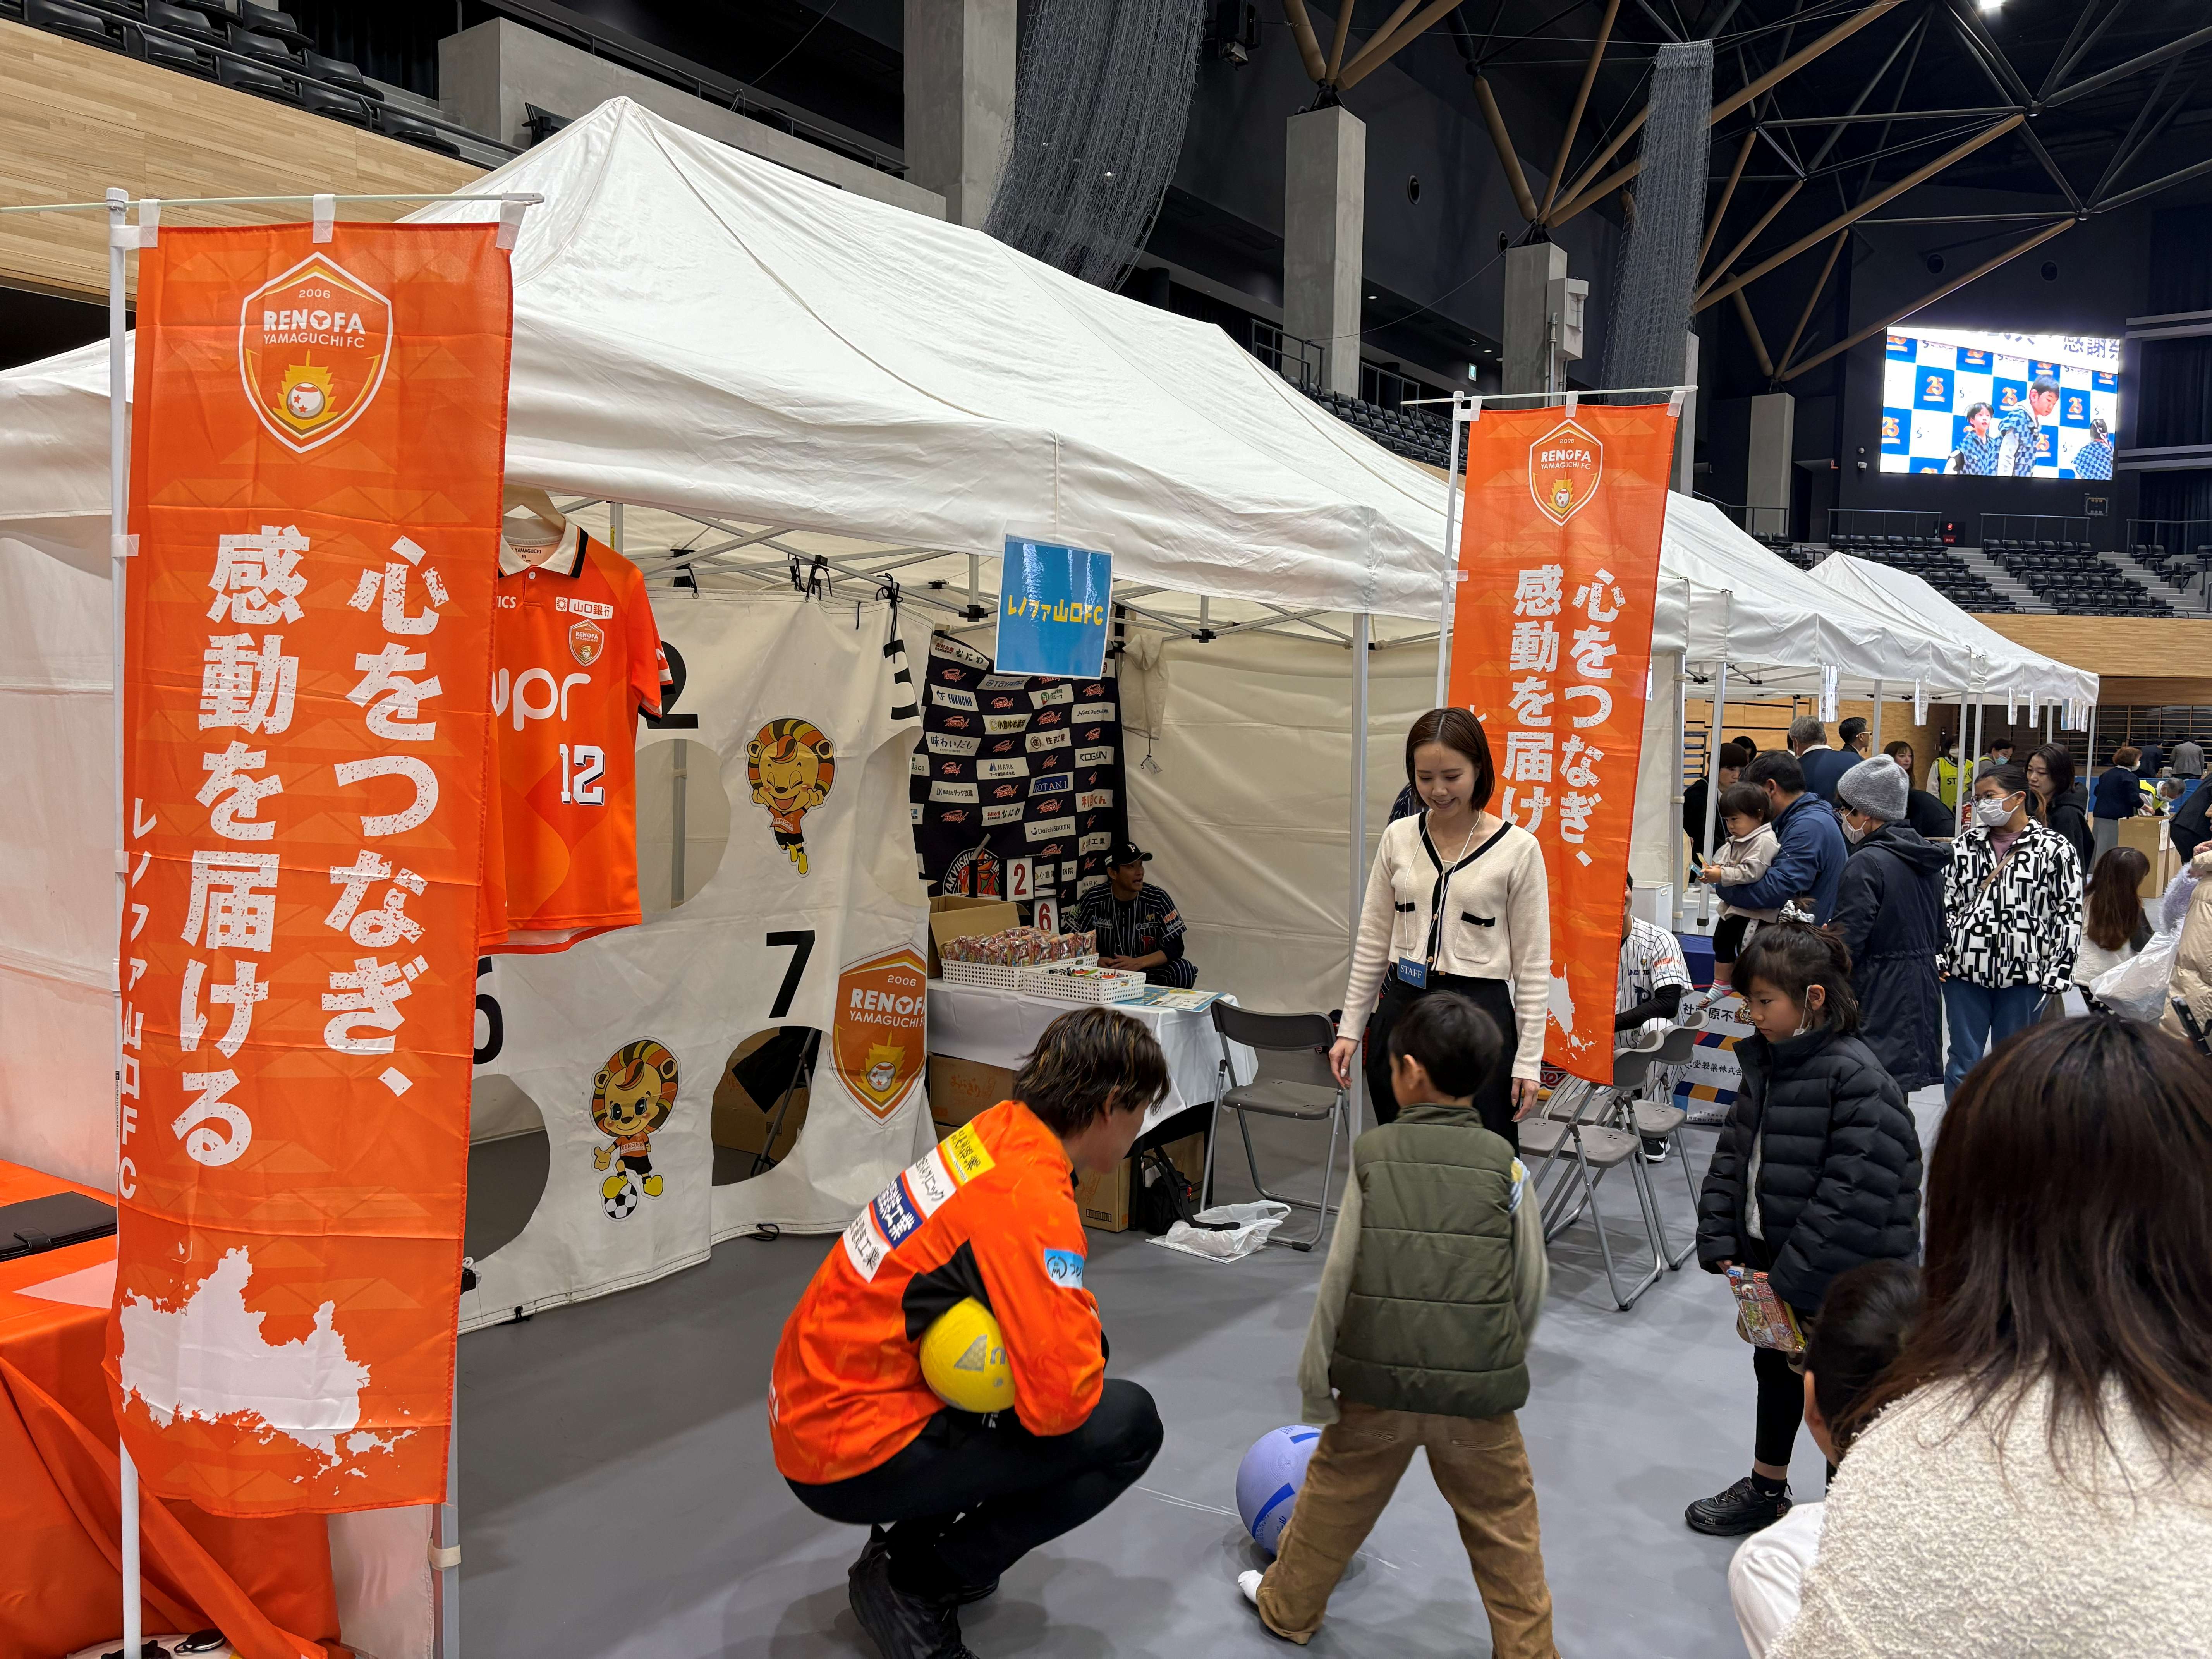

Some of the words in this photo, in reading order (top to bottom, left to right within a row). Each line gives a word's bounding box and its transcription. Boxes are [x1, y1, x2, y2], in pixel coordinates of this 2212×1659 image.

[299, 289, 330, 299] 2006
[264, 309, 366, 335] RENOFA
[263, 331, 344, 347] YAMAGUCHI
[347, 335, 365, 349] FC
[1541, 449, 1592, 463] RENOFA
[1540, 461, 1580, 471] YAMAGUCHI
[1581, 462, 1591, 470] FC
[497, 595, 517, 608] ICS
[574, 601, 610, 617] 山口銀行
[1008, 594, 1103, 625] レノファ山口FC
[576, 631, 598, 639] RENOFA
[955, 648, 984, 665] なにわ
[948, 693, 973, 707] FUKUCHO
[1559, 567, 1626, 867] 心をつなぎ、
[931, 735, 972, 750] 味わいだし
[559, 743, 605, 807] 12
[1034, 780, 1067, 793] KOTANI
[322, 534, 448, 1097] 心をつなぎ、
[171, 524, 311, 1167] 感動を届ける
[945, 852, 974, 894] AKYUSH
[1013, 863, 1027, 896] 2
[1039, 903, 1051, 931] 6
[766, 930, 815, 1018] 7
[1400, 964, 1422, 979] STAFF
[887, 975, 917, 987] 2006
[119, 797, 157, 1199] レノファ山口FC
[849, 1010, 919, 1028] YAMAGUCHI
[1683, 1002, 1737, 1022] 社原不
